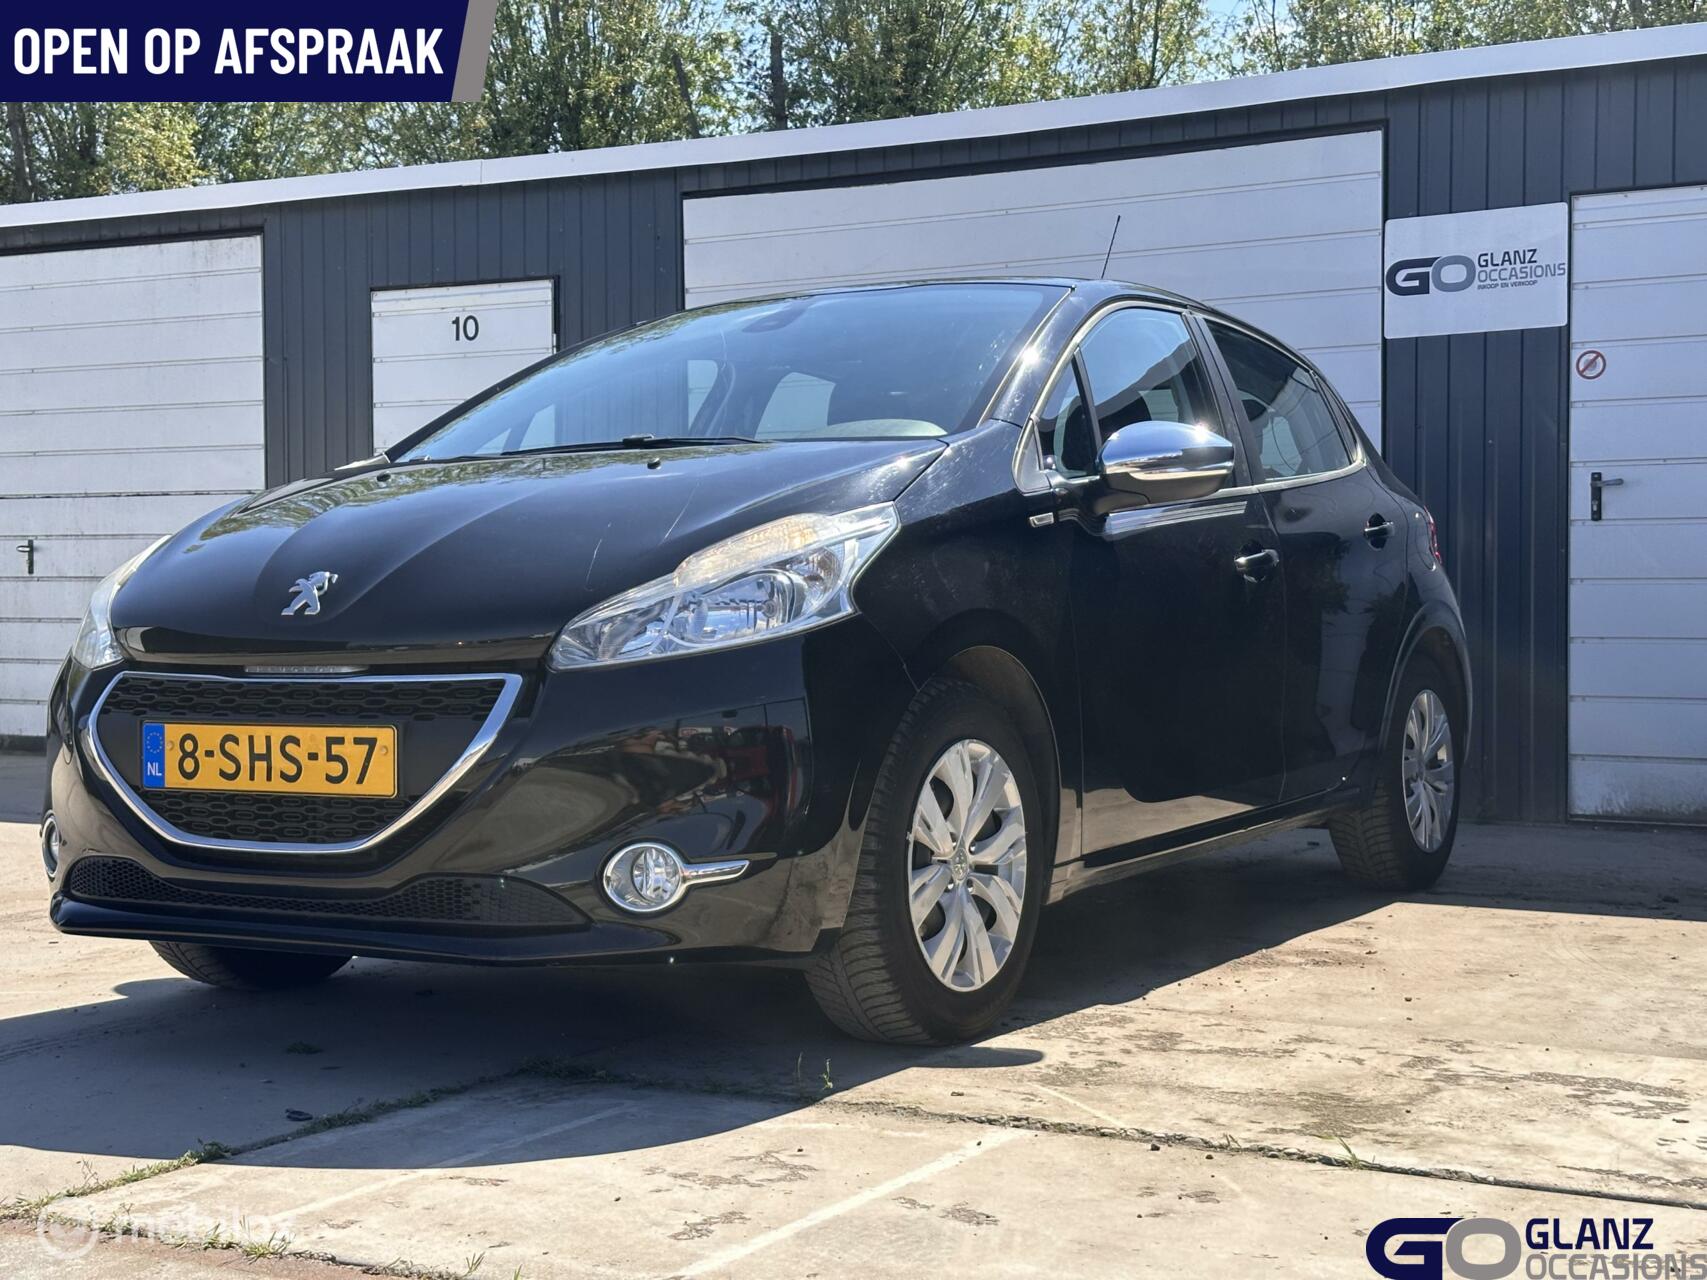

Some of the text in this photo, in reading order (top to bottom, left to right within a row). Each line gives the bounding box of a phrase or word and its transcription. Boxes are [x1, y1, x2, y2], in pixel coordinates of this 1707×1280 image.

[1477, 248, 1538, 268] GLANZ
[1385, 255, 1477, 296] GO
[1477, 262, 1567, 283] OCCASIONS
[451, 315, 480, 342] 10
[147, 762, 162, 777] NL
[178, 733, 378, 785] 8-SHS-57
